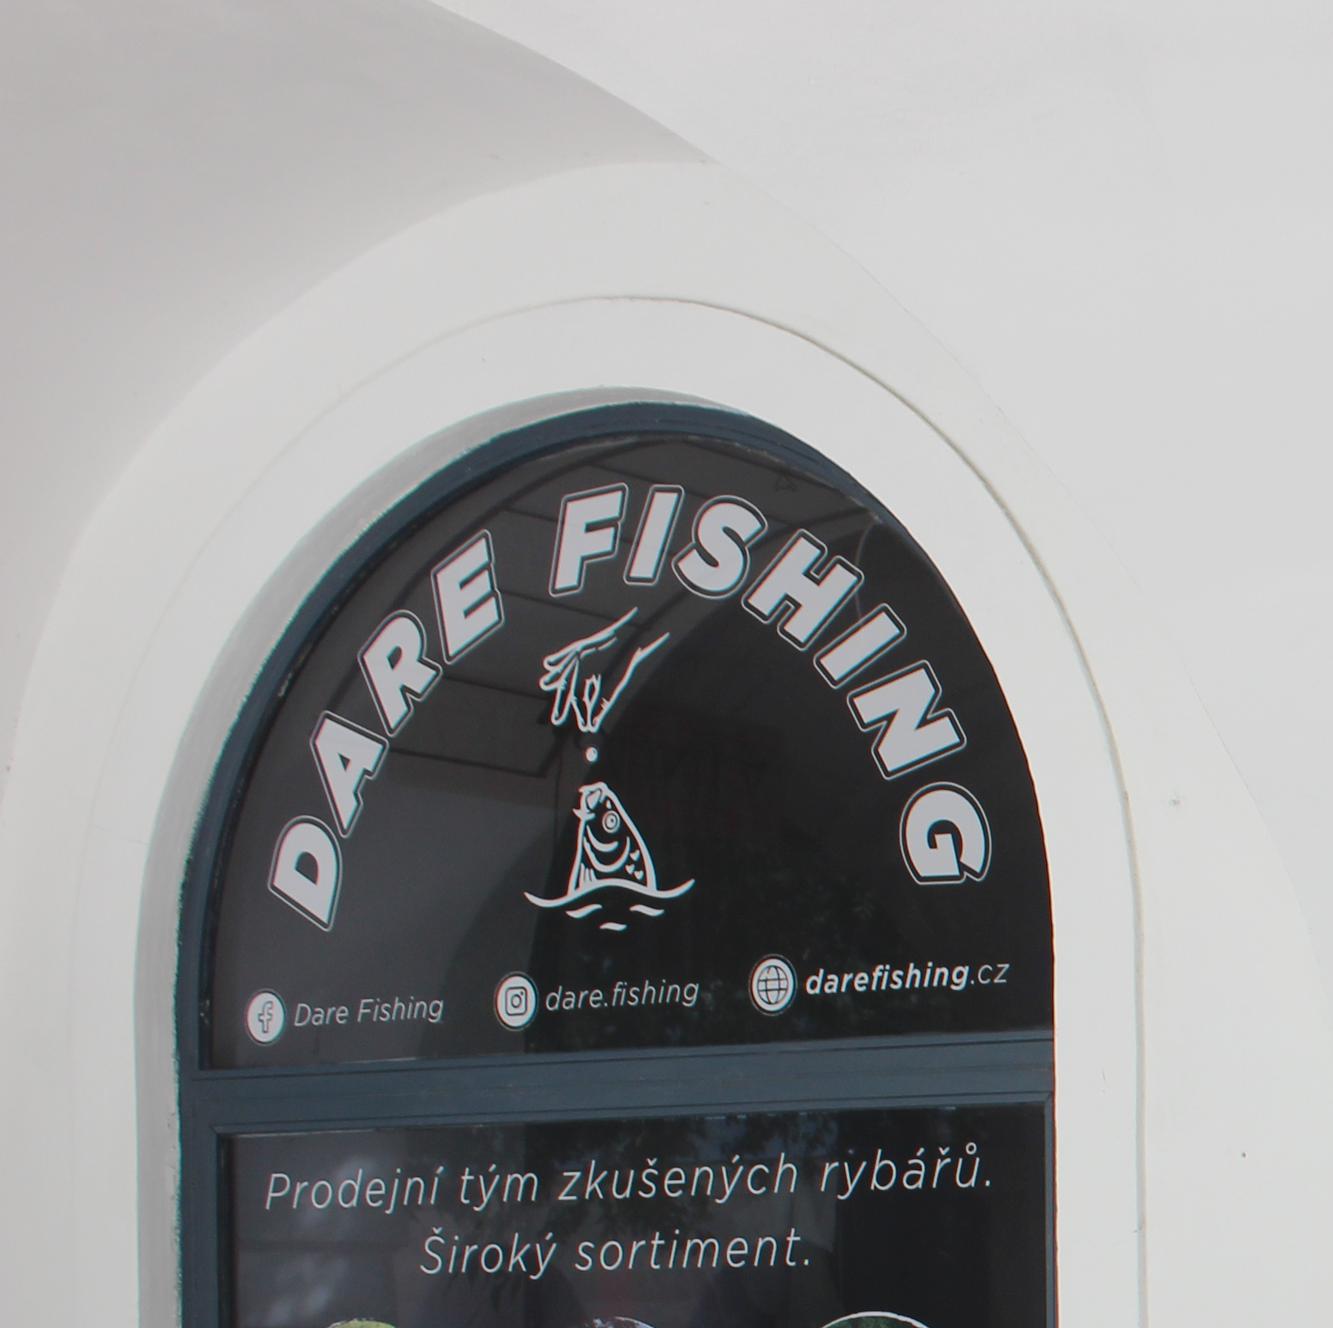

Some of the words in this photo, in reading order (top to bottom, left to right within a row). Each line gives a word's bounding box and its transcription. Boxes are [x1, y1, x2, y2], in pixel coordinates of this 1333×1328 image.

[268, 530, 505, 931] DARE
[549, 483, 991, 885] FISHING
[545, 979, 699, 1013] dare.fishing
[805, 960, 1011, 997] darefishing.cz
[294, 1001, 350, 1028] Dare
[357, 996, 444, 1027] Fishing
[264, 1166, 445, 1212] Prodejní
[460, 1165, 538, 1211] tým
[558, 1152, 799, 1205] zkušených
[819, 1141, 994, 1199] rybářů.
[420, 1227, 556, 1281] Široký
[575, 1228, 811, 1272] sortiment.
